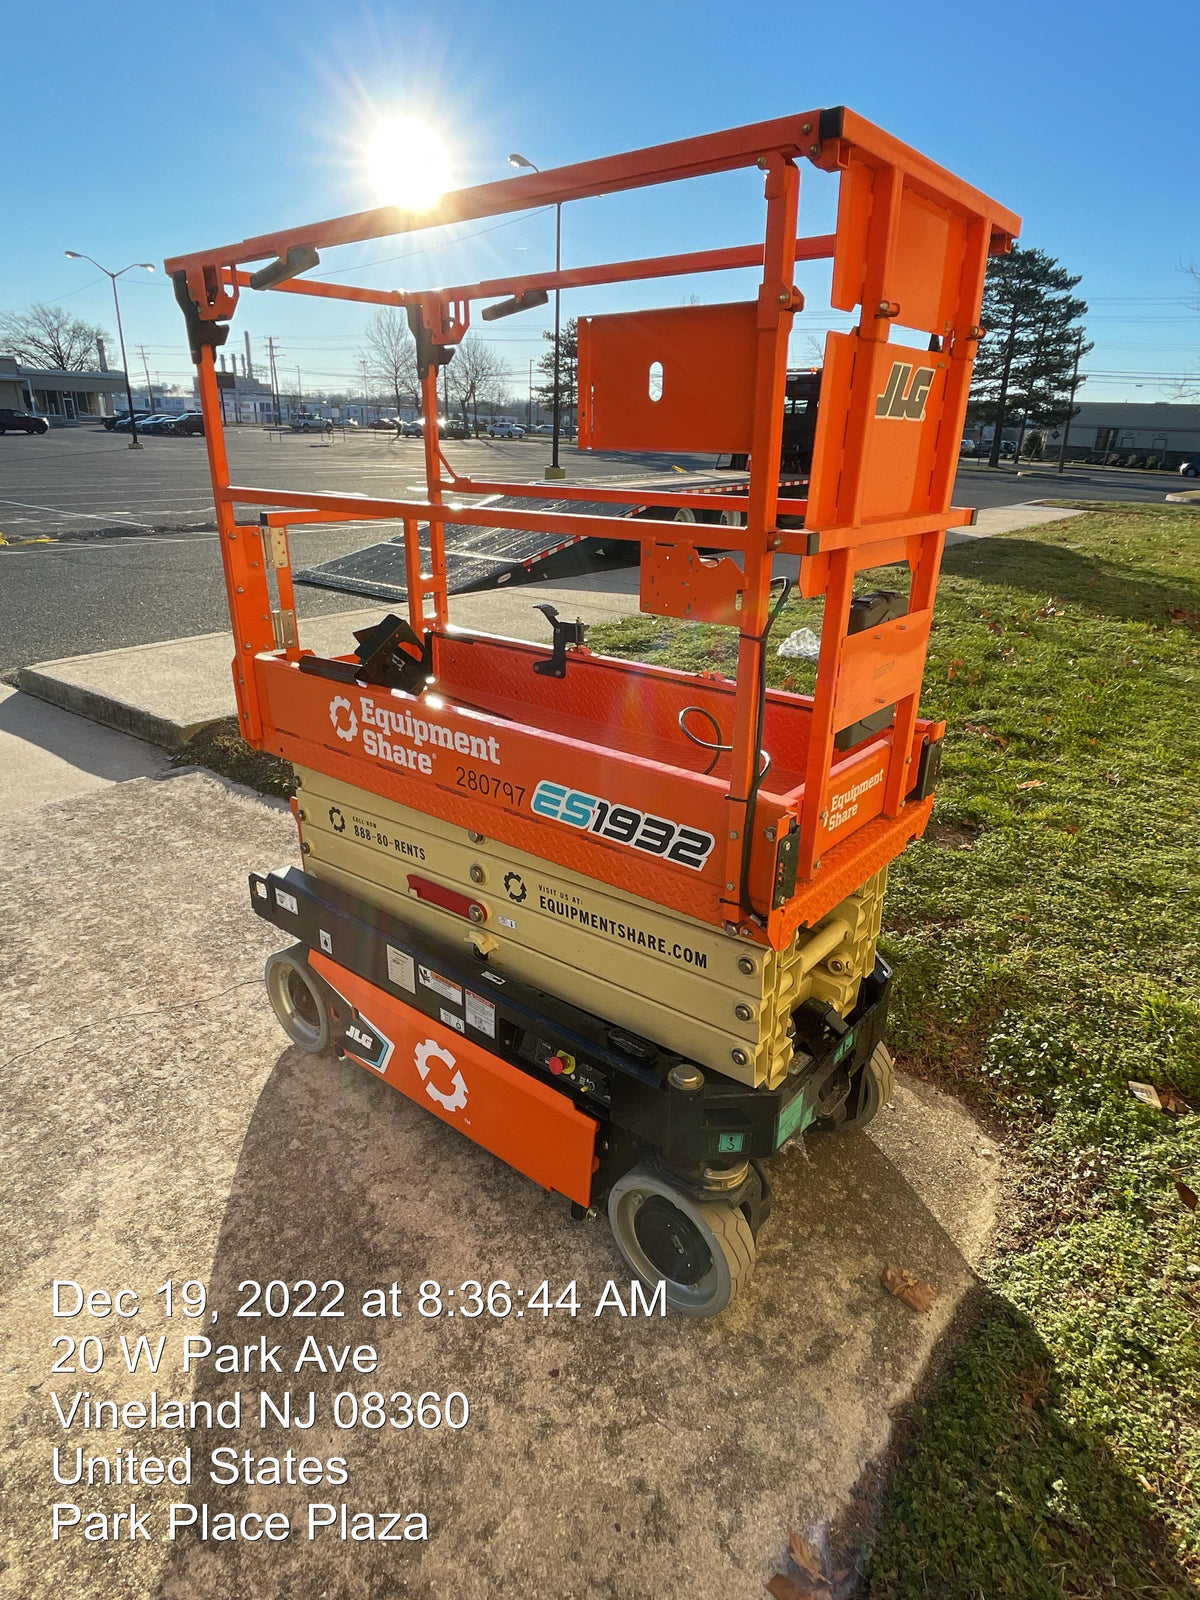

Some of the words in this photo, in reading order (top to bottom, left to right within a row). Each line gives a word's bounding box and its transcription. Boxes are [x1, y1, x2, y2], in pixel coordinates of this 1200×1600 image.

[875, 361, 936, 421] JLG
[360, 696, 501, 764] Equipment
[362, 727, 433, 775] Share
[455, 766, 526, 807] 280797
[830, 768, 884, 812] Equipment
[532, 782, 714, 870] ES1932
[828, 803, 858, 831] Share
[353, 824, 426, 860] 888-80-RENTS
[538, 884, 557, 896] VISIT
[559, 892, 569, 900] US
[540, 895, 708, 969] EQUIPMENTSHARE.COM
[345, 1025, 374, 1050] JLG
